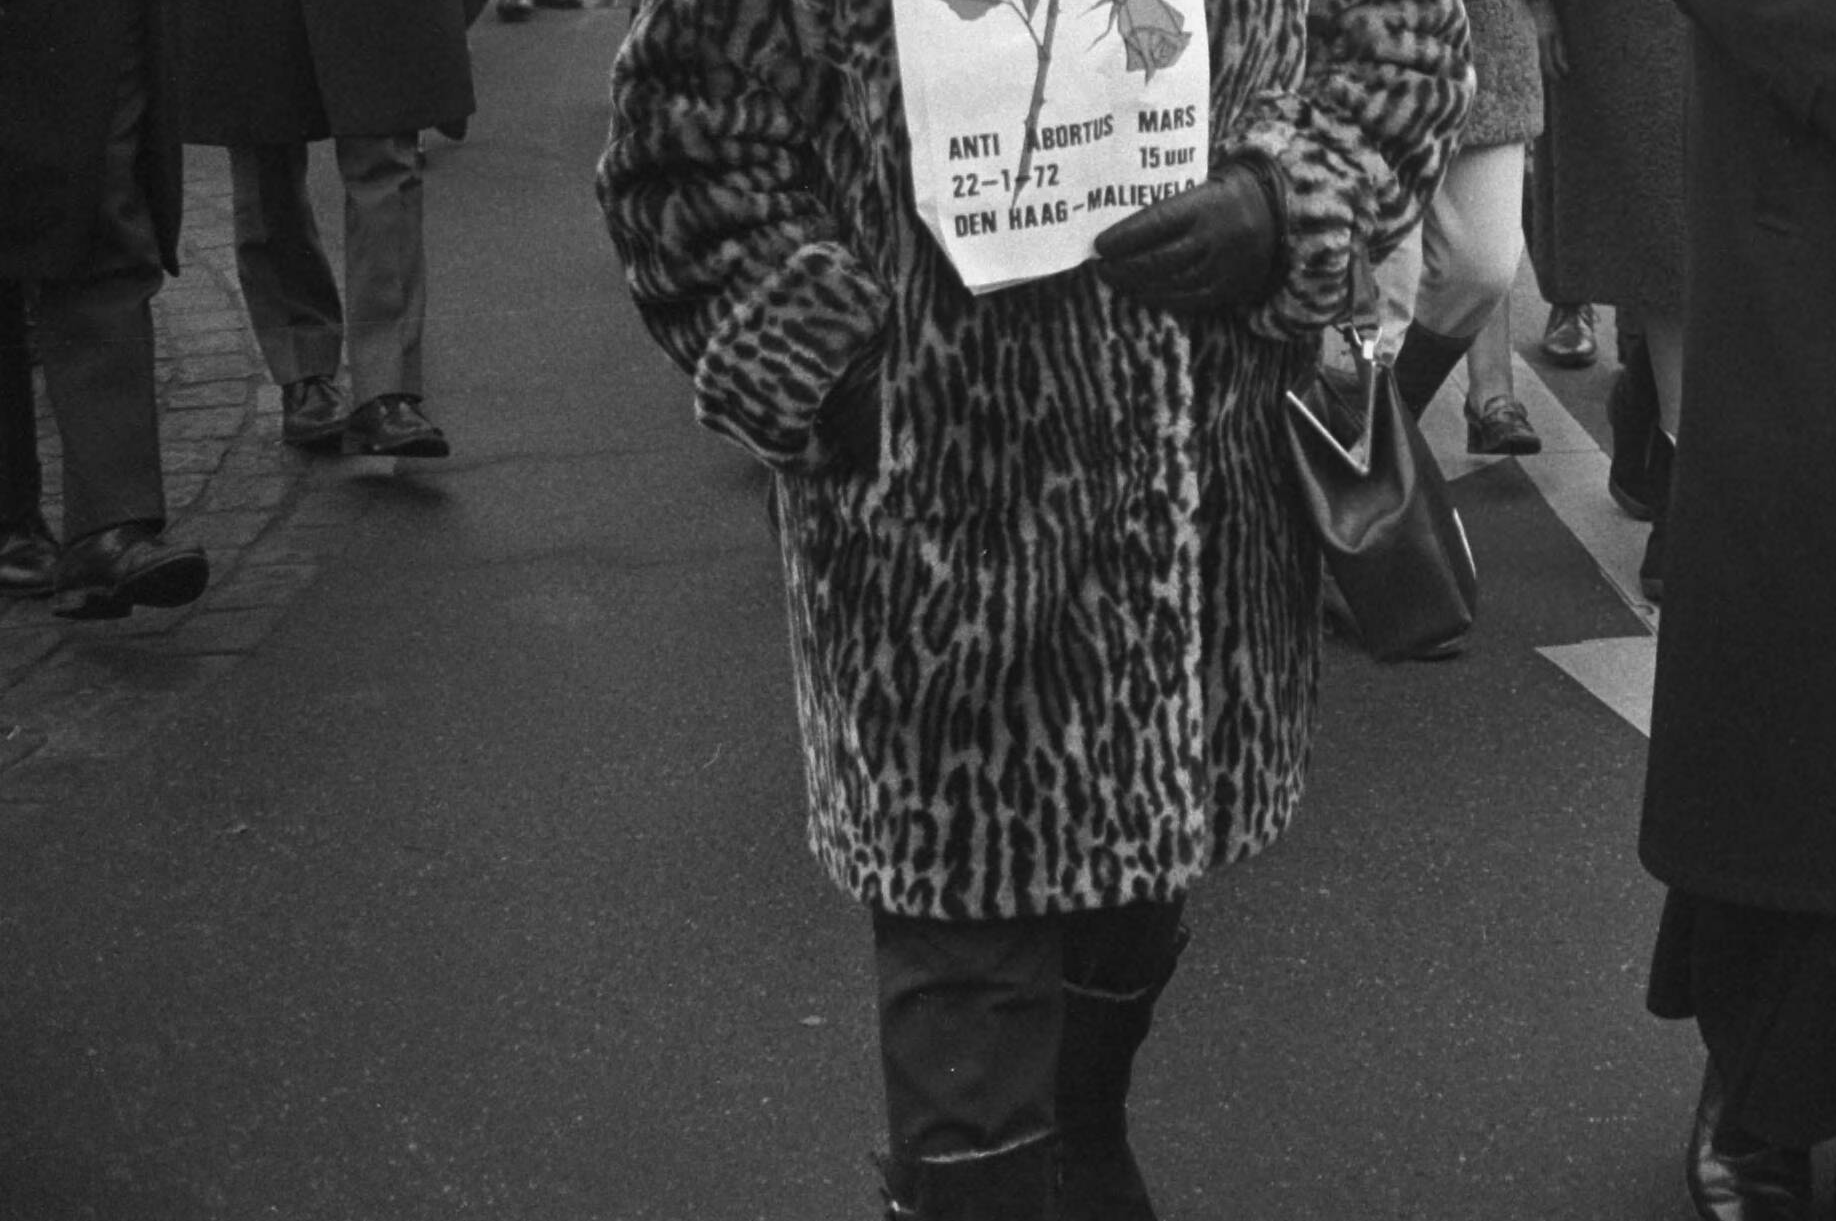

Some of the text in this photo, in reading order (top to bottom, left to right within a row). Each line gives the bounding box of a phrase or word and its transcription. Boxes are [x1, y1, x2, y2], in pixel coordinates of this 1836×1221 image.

[949, 105, 1196, 160] ANTI ABORTUS MARS
[1139, 146, 1161, 169] 15
[1164, 146, 1196, 167] uur
[954, 210, 998, 238] DEN
